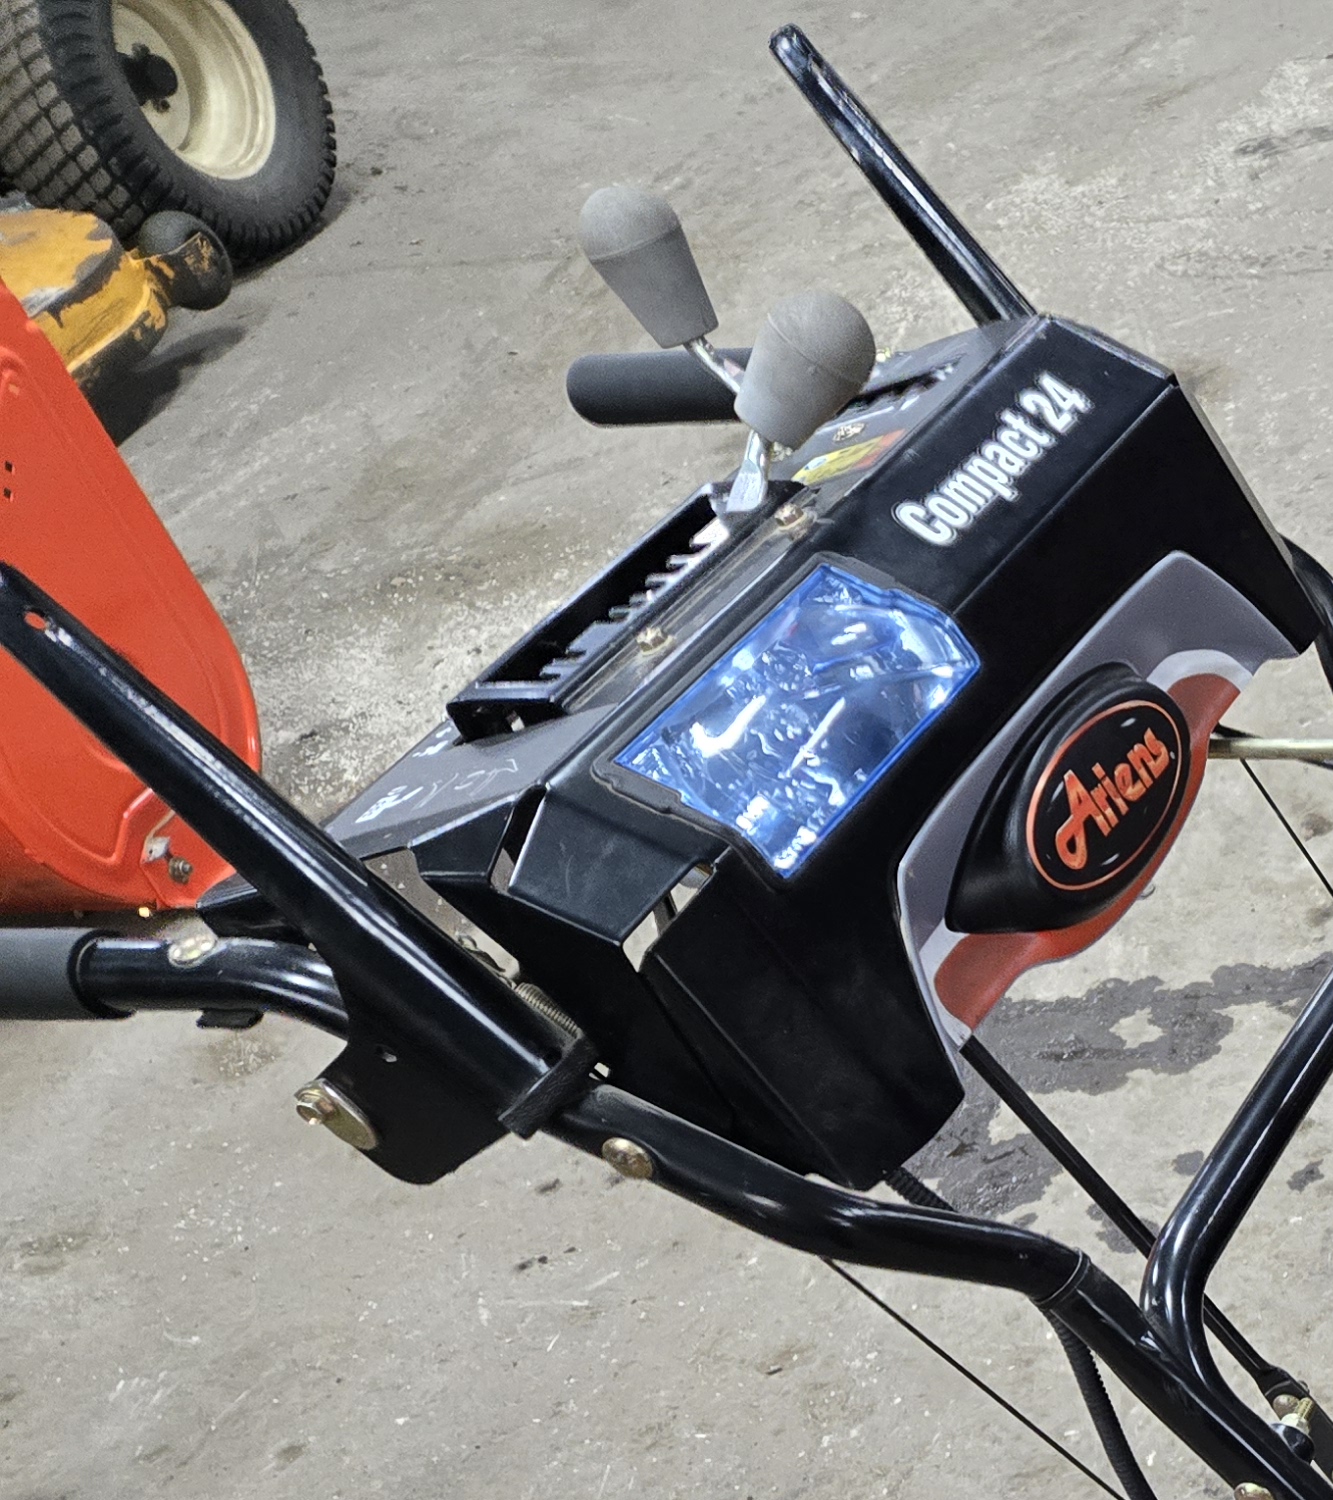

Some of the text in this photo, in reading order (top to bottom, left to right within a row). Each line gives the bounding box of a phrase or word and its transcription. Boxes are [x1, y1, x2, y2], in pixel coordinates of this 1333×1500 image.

[892, 408, 1057, 546] Compact
[1018, 371, 1095, 435] 24
[1055, 727, 1170, 870] Ariens
